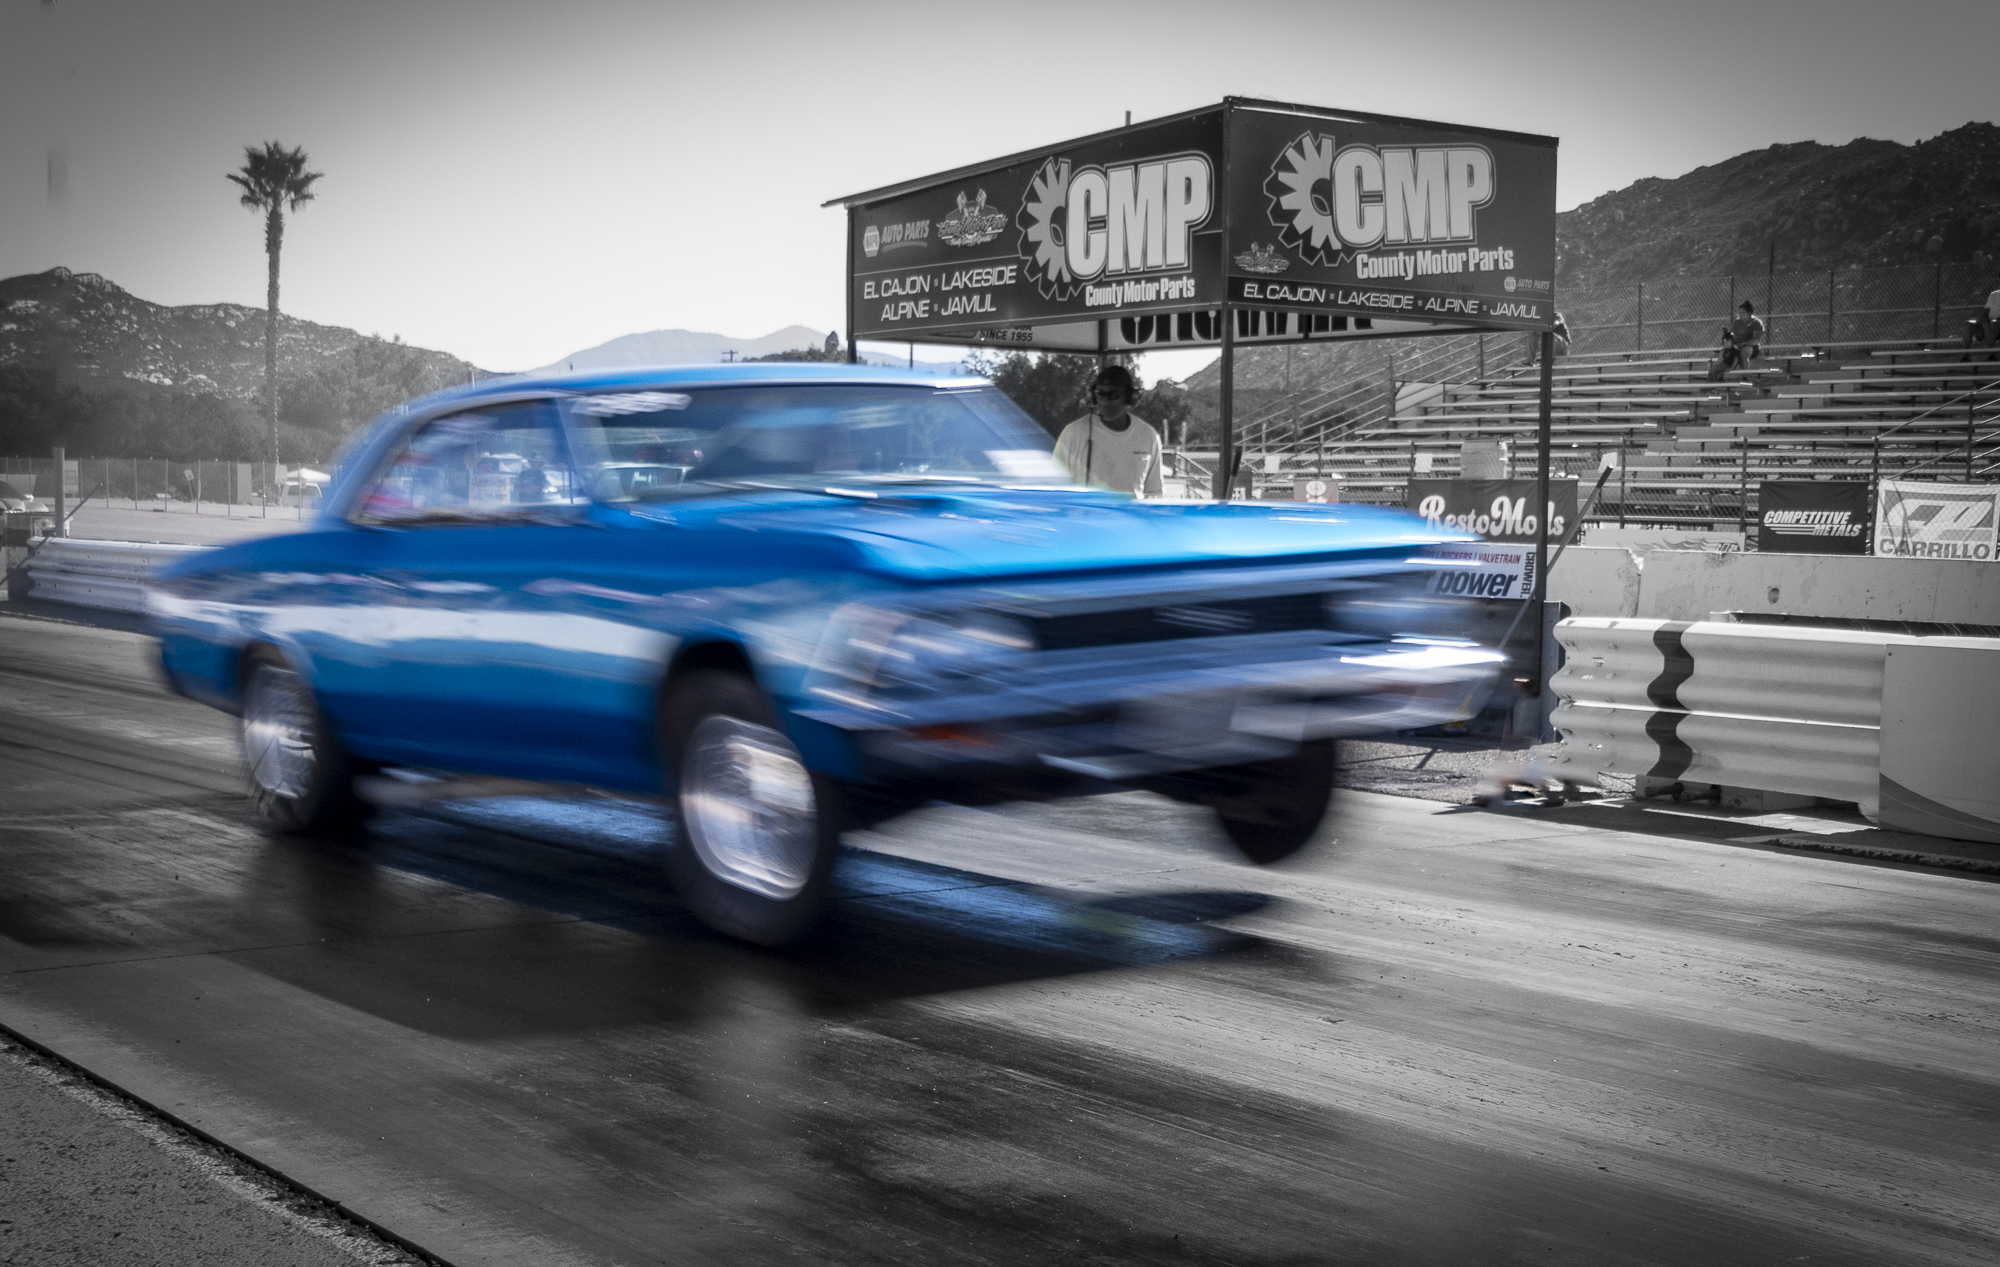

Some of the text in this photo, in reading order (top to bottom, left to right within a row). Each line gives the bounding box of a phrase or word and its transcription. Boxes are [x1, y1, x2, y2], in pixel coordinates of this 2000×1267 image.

[1332, 147, 1493, 246] CMP
[1066, 155, 1212, 280] CMP
[881, 223, 903, 243] AUTO
[904, 219, 930, 241] PARTS
[1356, 246, 1514, 281] County Motor Parts
[863, 265, 1018, 300] EL CAJON LAKESIDE
[1085, 276, 1195, 308] County Motor Parts
[1517, 279, 1550, 290] AUTO PARTS
[881, 293, 997, 322] ALPINE JAMUL
[1243, 283, 1541, 319] EL CAJON LAKESIDE ALPINE JAMUL
[980, 330, 1033, 342] SINCE 1955
[1763, 510, 1851, 525] COMPETITIVE
[1812, 524, 1862, 537] METALS
[1478, 552, 1521, 565] VALVETRAIN
[1879, 538, 1991, 560] CARRILLO
[1433, 571, 1518, 597] power
